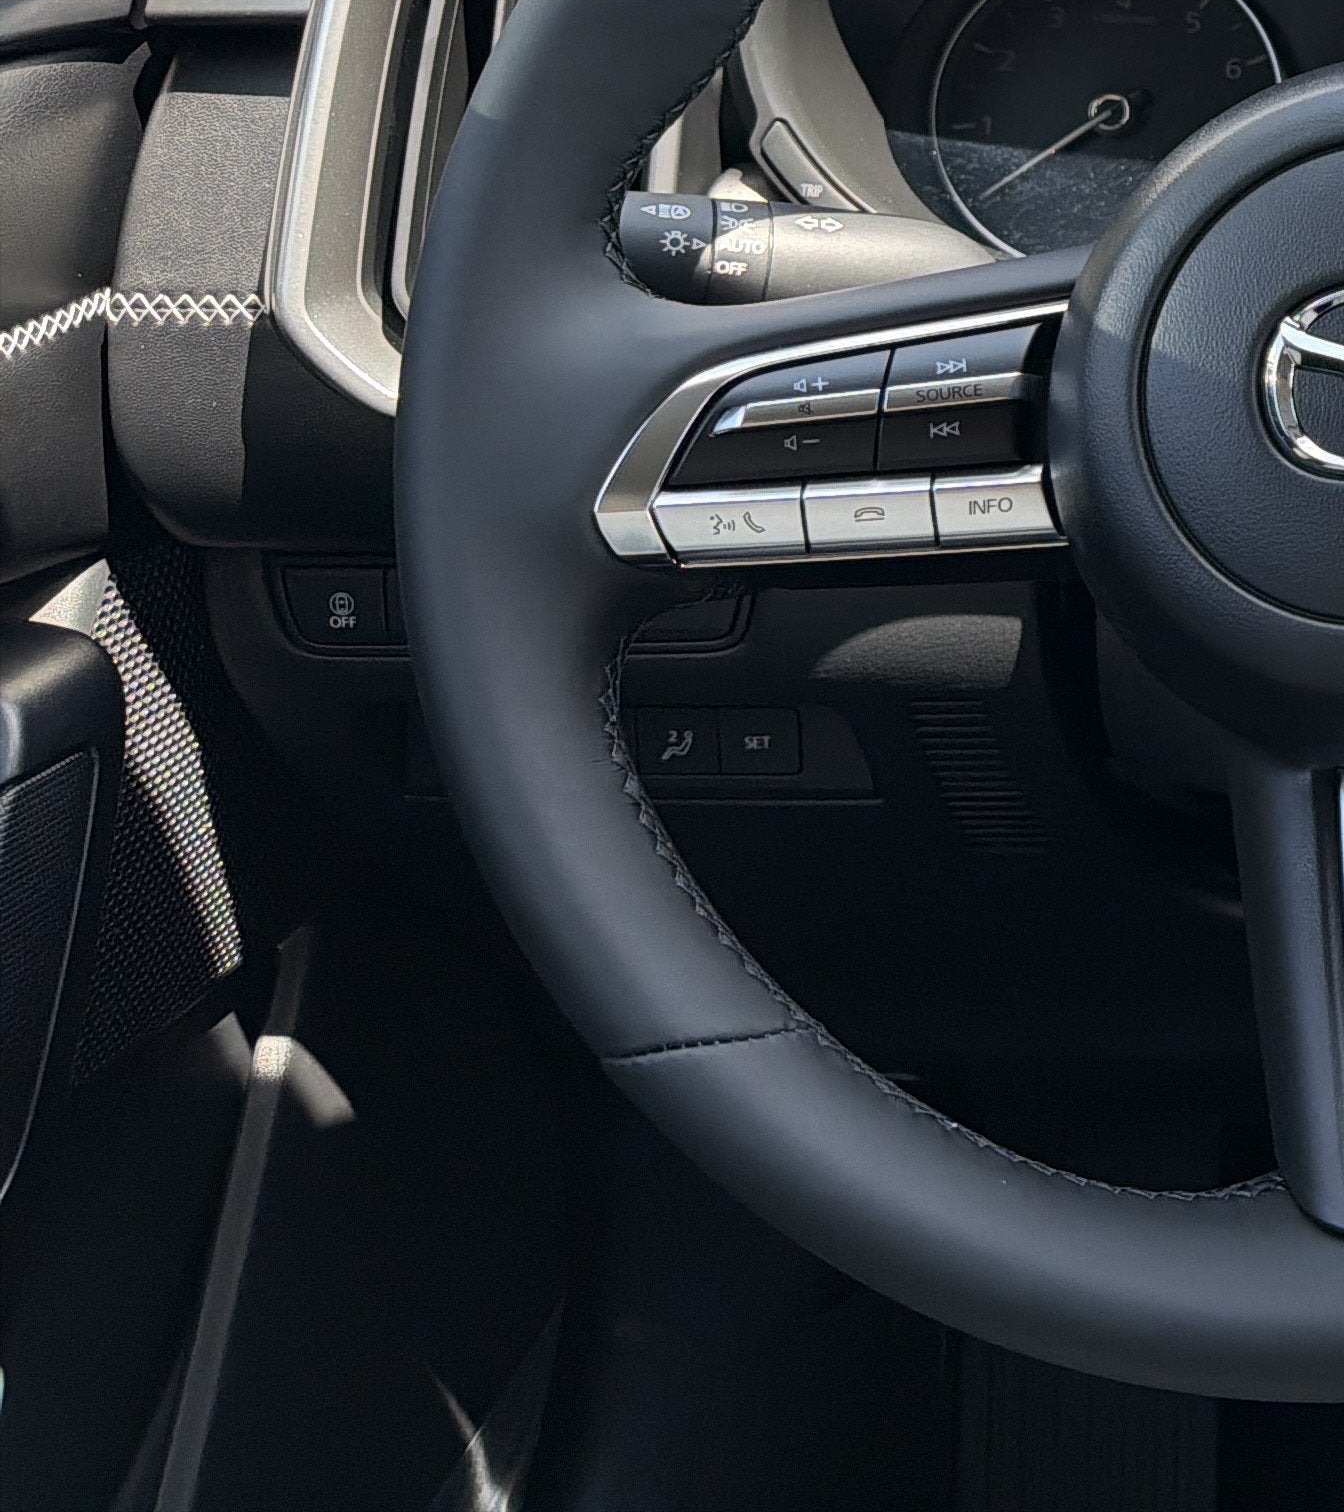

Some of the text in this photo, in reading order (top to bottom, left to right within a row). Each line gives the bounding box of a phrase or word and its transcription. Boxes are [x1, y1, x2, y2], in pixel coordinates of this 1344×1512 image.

[1186, 14, 1201, 34] 5
[1226, 59, 1243, 80] 6
[801, 183, 823, 199] TRIP
[718, 238, 766, 254] AUTO
[715, 261, 748, 276] OFF
[916, 383, 984, 403] SOURCE
[968, 496, 1014, 517] INFO
[329, 616, 357, 629] OFF
[744, 735, 771, 750] SET
